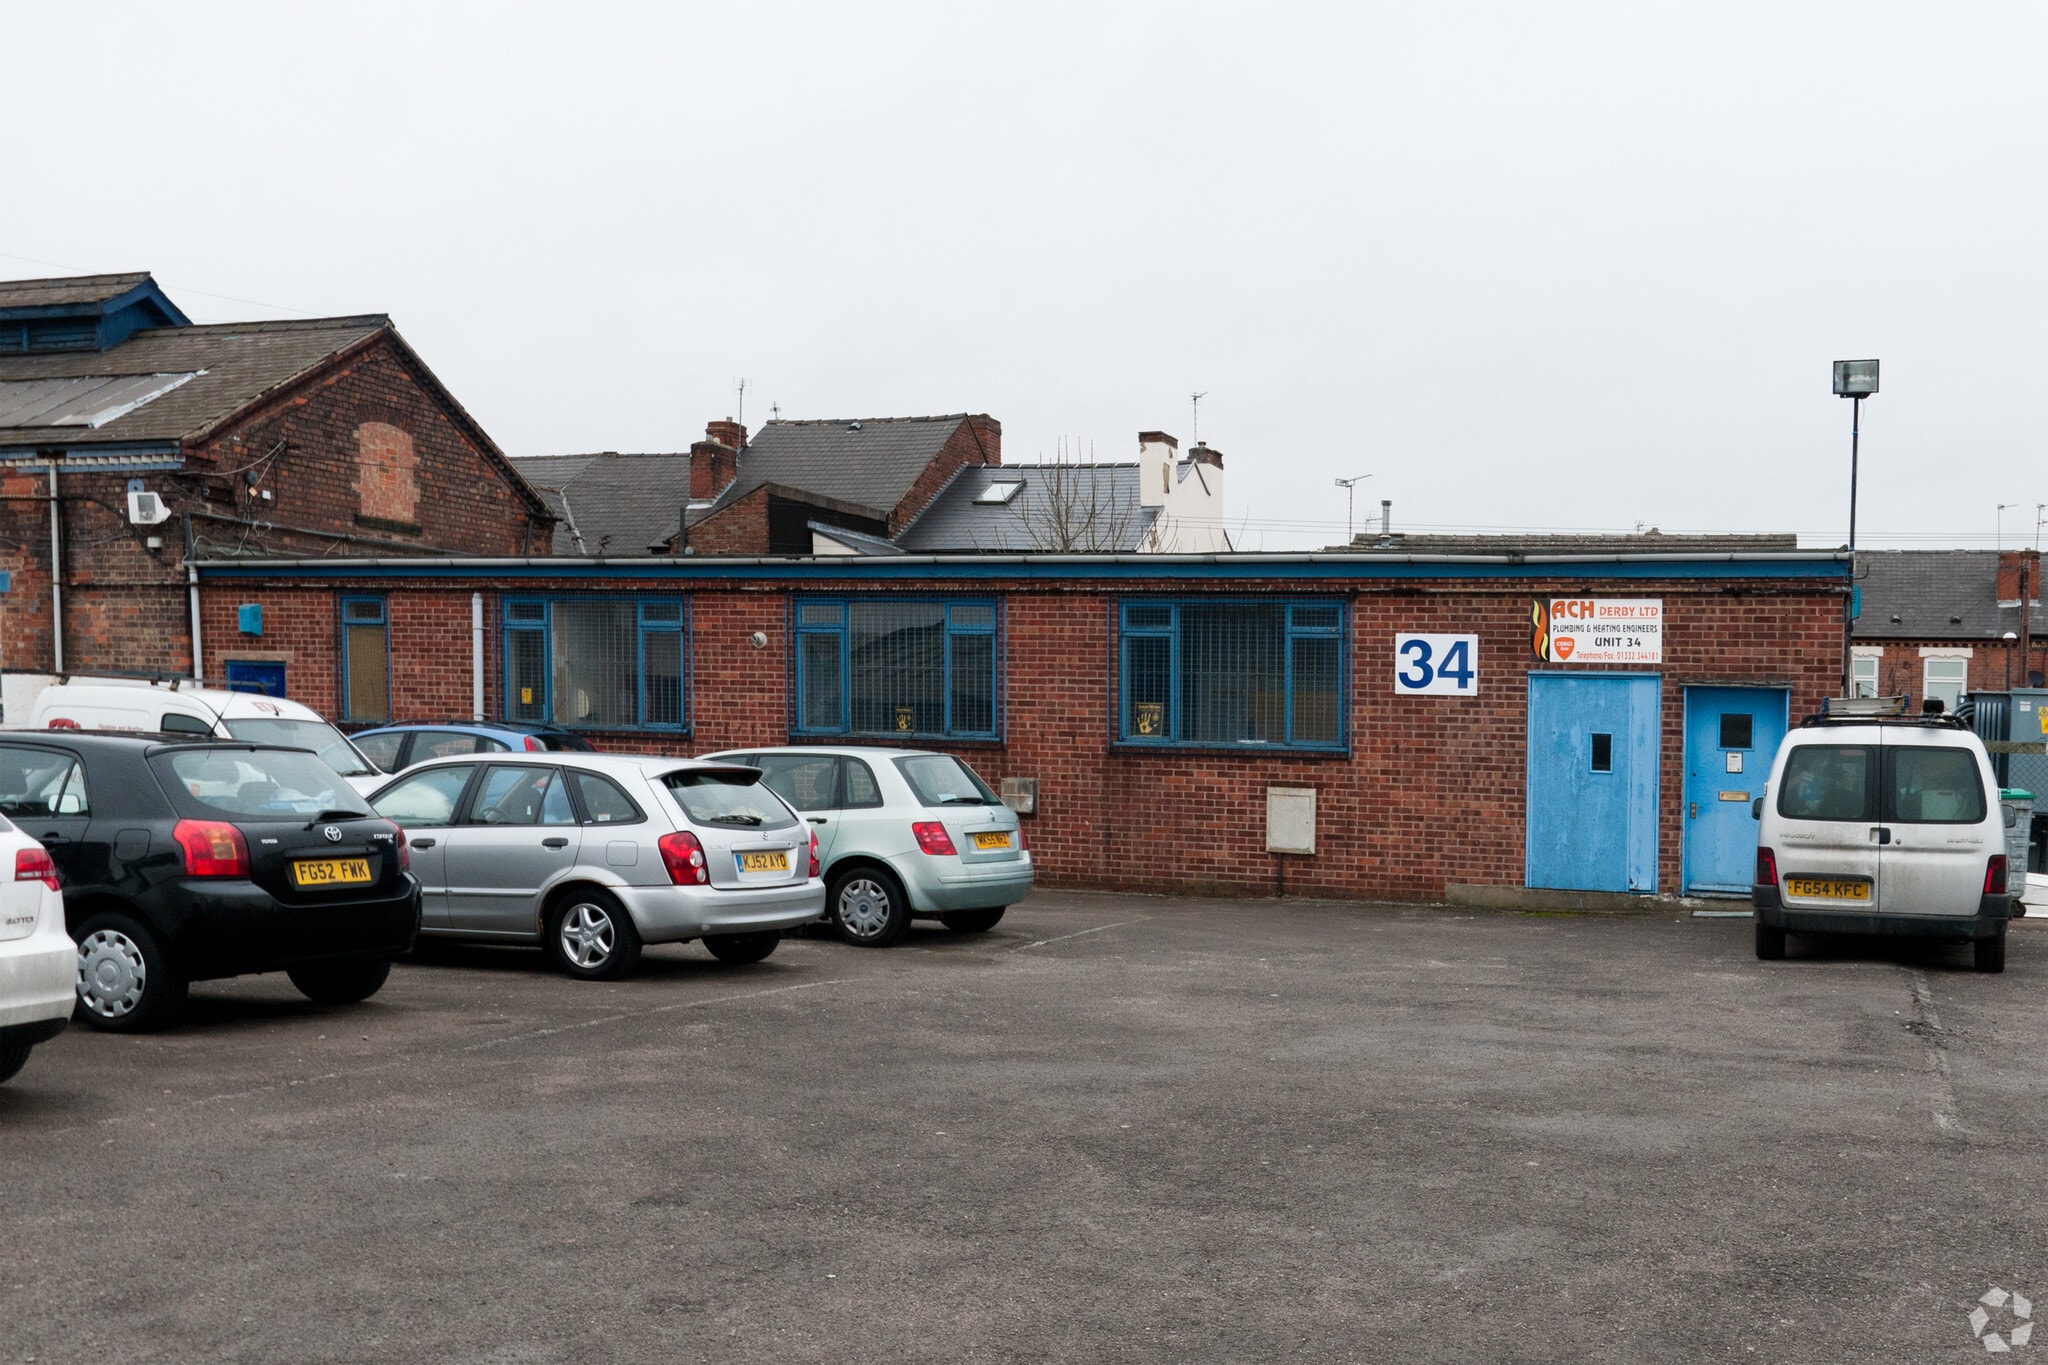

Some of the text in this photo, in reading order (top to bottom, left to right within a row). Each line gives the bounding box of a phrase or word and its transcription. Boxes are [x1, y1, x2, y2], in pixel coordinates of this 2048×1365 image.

[1551, 600, 1659, 620] ACH DERBY LTD
[1552, 624, 1658, 634] PLUMBING & HEATING ENGINEERS
[1595, 637, 1642, 648] UNIT 34
[1616, 651, 1635, 660] 01332
[1399, 639, 1474, 689] 34
[742, 855, 768, 870] KJ52
[299, 861, 367, 881] FG52 FWK
[1794, 881, 1862, 897] FG54 KFC
